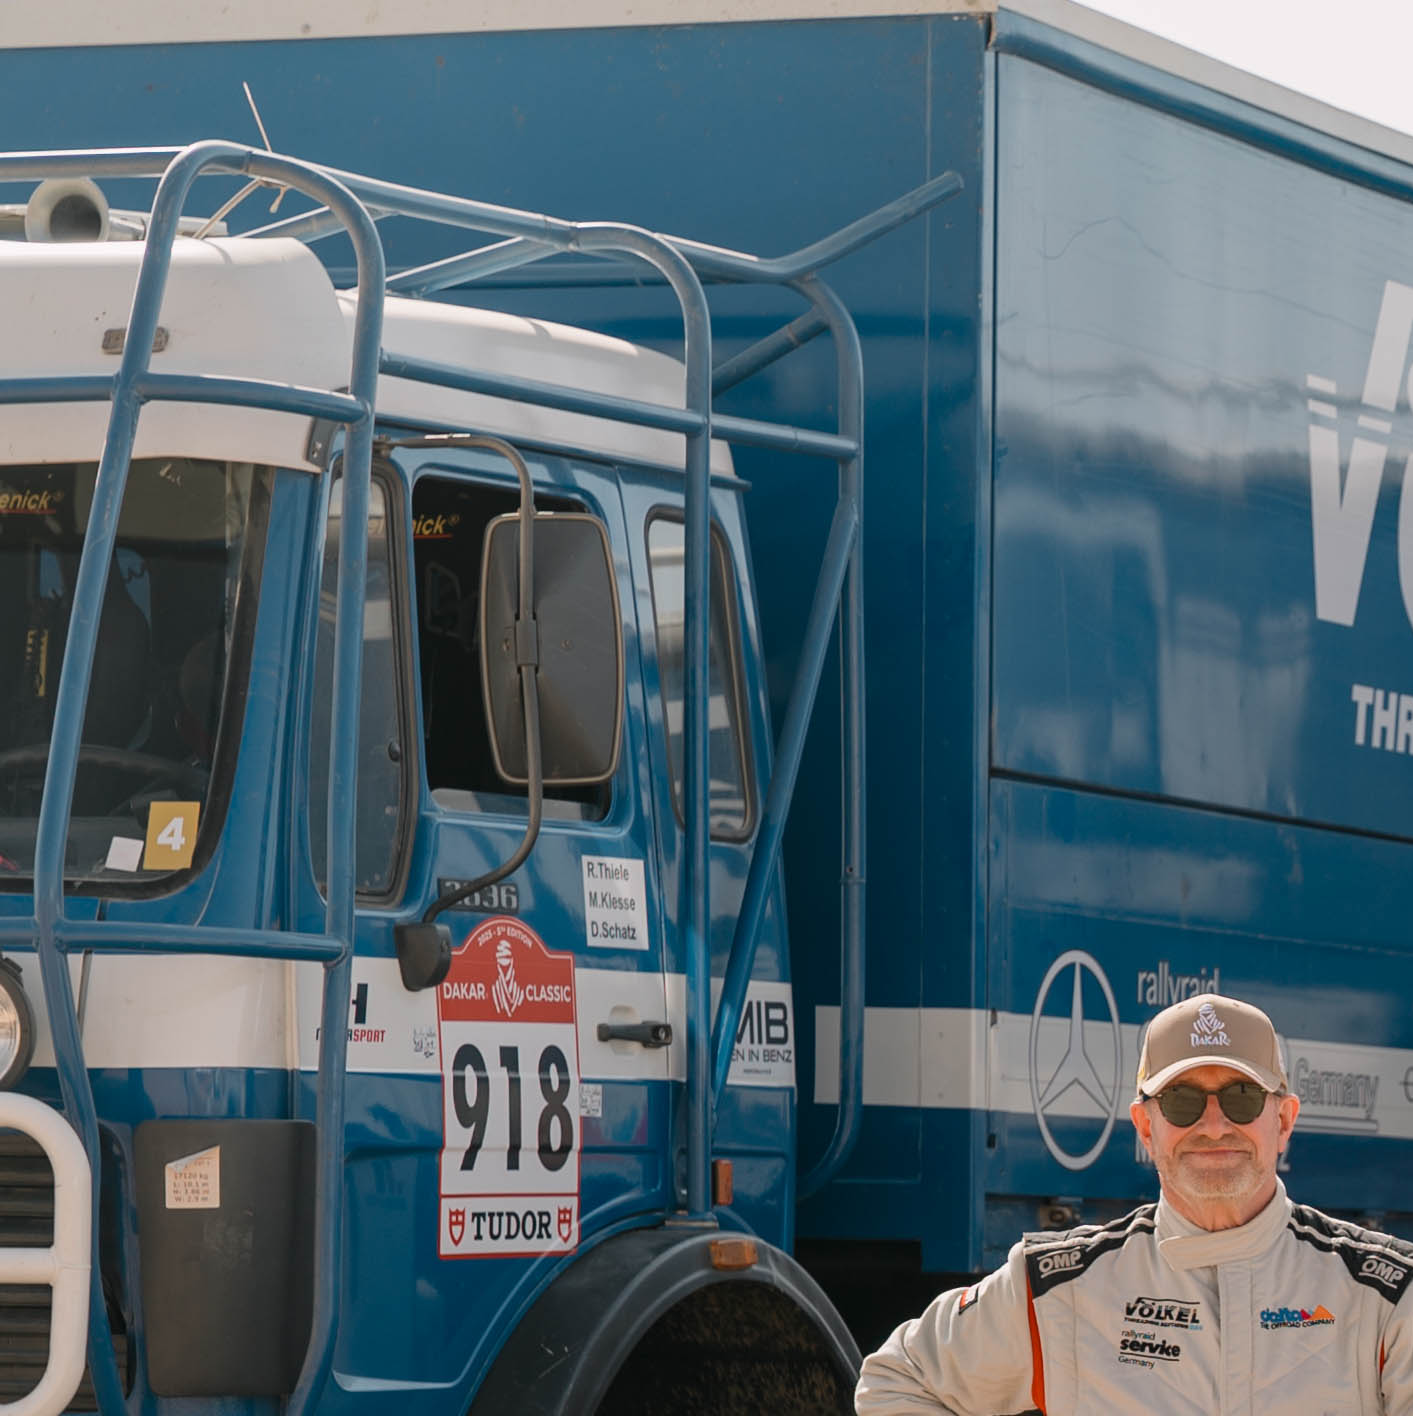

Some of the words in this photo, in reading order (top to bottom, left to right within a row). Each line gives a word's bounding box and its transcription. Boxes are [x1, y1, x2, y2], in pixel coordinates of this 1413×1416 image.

[157, 817, 186, 851] 4
[587, 862, 629, 880] R.Thiele
[591, 921, 637, 940] D.Schatz
[443, 982, 486, 999] DAKAR
[525, 984, 571, 1003] CLASSIC
[1190, 1032, 1229, 1048] DAKAR
[748, 1049, 759, 1062] IN
[763, 1049, 792, 1063] BENZ
[1295, 1057, 1380, 1120] Germany
[452, 1043, 574, 1172] 918
[471, 1210, 553, 1242] TUDOR
[1038, 1250, 1082, 1274] OMP
[1361, 1258, 1404, 1283] OMP
[1125, 1296, 1200, 1323] VÖLKEL
[1120, 1339, 1180, 1357] service
